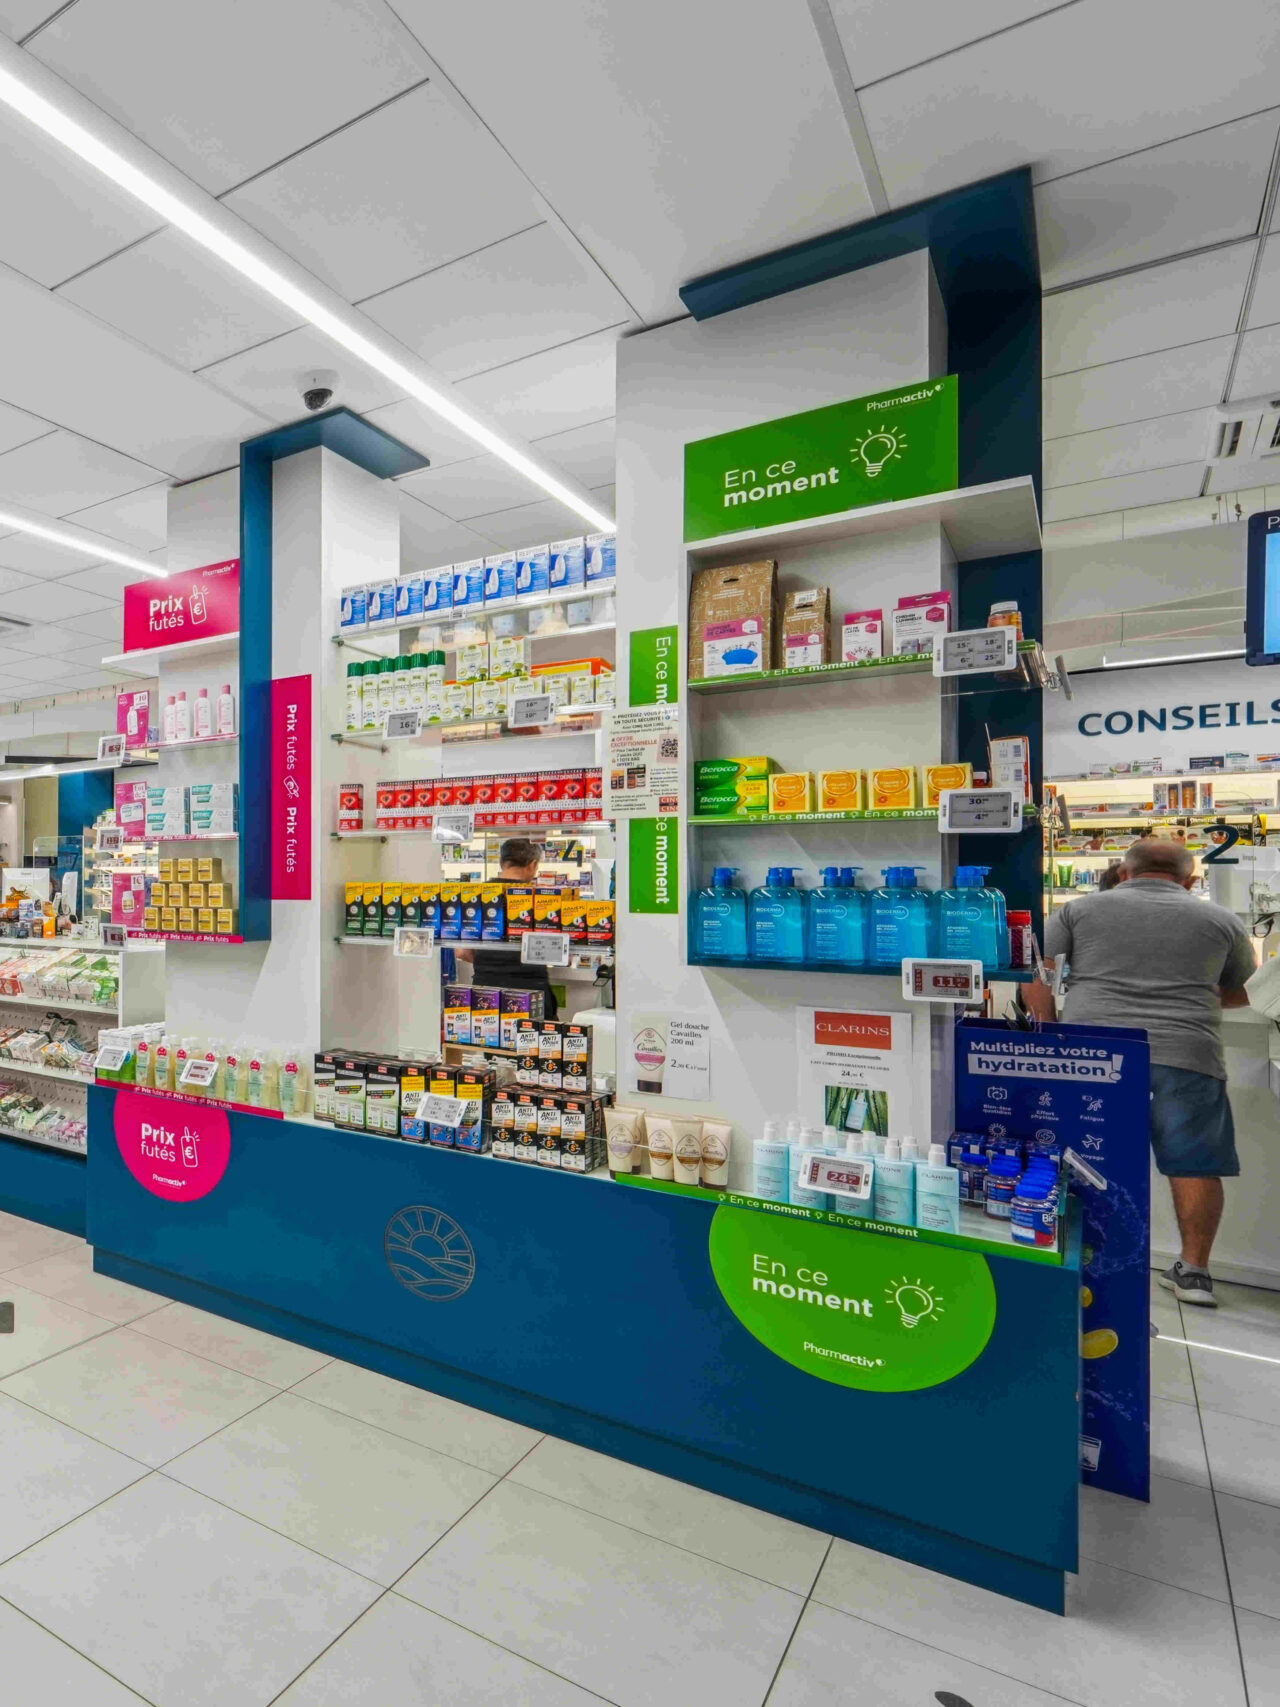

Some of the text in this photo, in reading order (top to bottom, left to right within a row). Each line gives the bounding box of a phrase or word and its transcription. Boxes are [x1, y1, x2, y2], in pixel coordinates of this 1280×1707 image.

[867, 389, 934, 412] Pharmactiv
[724, 460, 797, 489] En ce
[723, 467, 839, 507] moment
[149, 594, 184, 616] Prix
[149, 613, 185, 632] futés
[656, 636, 671, 658] En
[656, 662, 668, 680] ce
[775, 668, 789, 676] En
[808, 660, 860, 672] moment
[878, 656, 895, 664] En
[898, 654, 915, 662] ce
[286, 704, 297, 770] Prix futés
[700, 765, 739, 774] Berocca
[762, 813, 775, 821] En
[795, 811, 846, 820] moment
[864, 810, 880, 818] En
[286, 807, 297, 873] Prix futés
[1201, 824, 1240, 865] 2
[561, 839, 583, 867] 4
[656, 835, 670, 904] moment
[138, 931, 148, 939] Prix
[670, 1021, 710, 1031] Gel douche
[816, 1022, 890, 1036] CLARINS
[970, 1041, 1108, 1058] Multipliez votre
[977, 1057, 1106, 1078] hydratation
[141, 1087, 152, 1095] Prix
[173, 1092, 184, 1100] Prix
[206, 1098, 218, 1107] Prix
[1030, 1114, 1060, 1122] physique
[1036, 1109, 1055, 1117] Effort
[1079, 1115, 1105, 1123] Fatigue
[141, 1122, 176, 1147] Prix
[140, 1141, 176, 1163] futés
[152, 1173, 183, 1187] Pharmactiv
[730, 1195, 919, 1238] En ce moment En ce moment
[753, 1253, 829, 1287] En ce
[752, 1275, 873, 1318] moment
[803, 1341, 875, 1369] Pharmactiv
